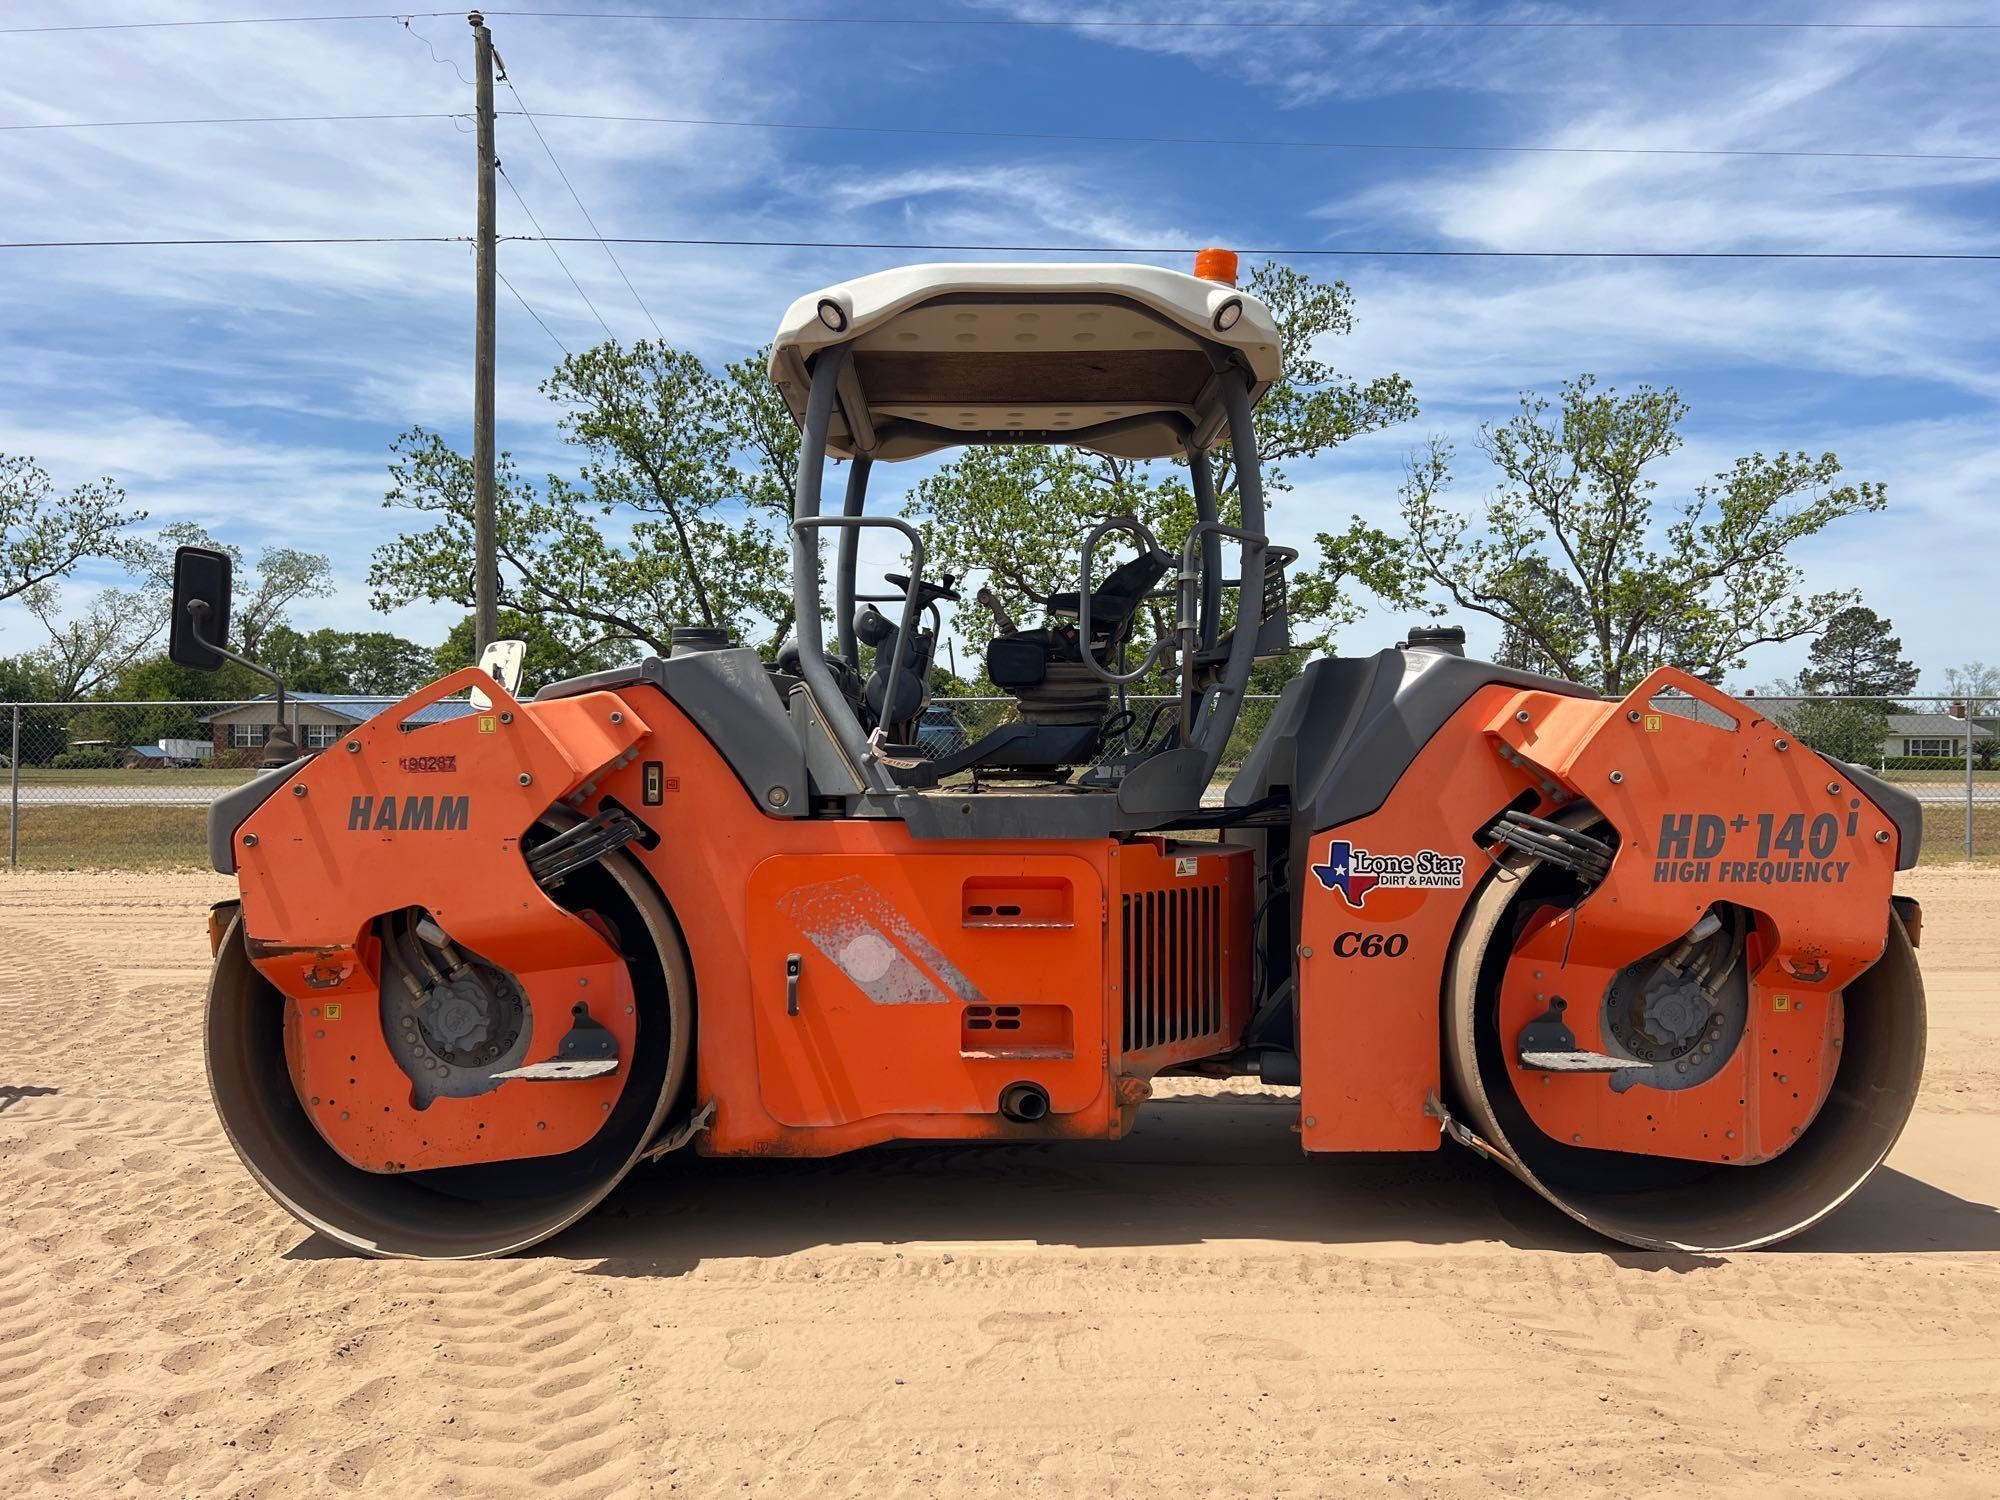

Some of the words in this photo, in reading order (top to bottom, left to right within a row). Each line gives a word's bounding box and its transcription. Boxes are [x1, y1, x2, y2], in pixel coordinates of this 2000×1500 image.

[348, 795, 470, 831] HAMM
[1353, 850, 1414, 874] Lone
[1416, 851, 1464, 874] Star
[1653, 861, 1712, 883] HIGH
[1718, 861, 1850, 885] FREQUENCY
[1380, 875, 1407, 886] DIRT
[1408, 875, 1418, 886] &
[1419, 875, 1461, 886] PAVING
[1332, 931, 1410, 958] C60
